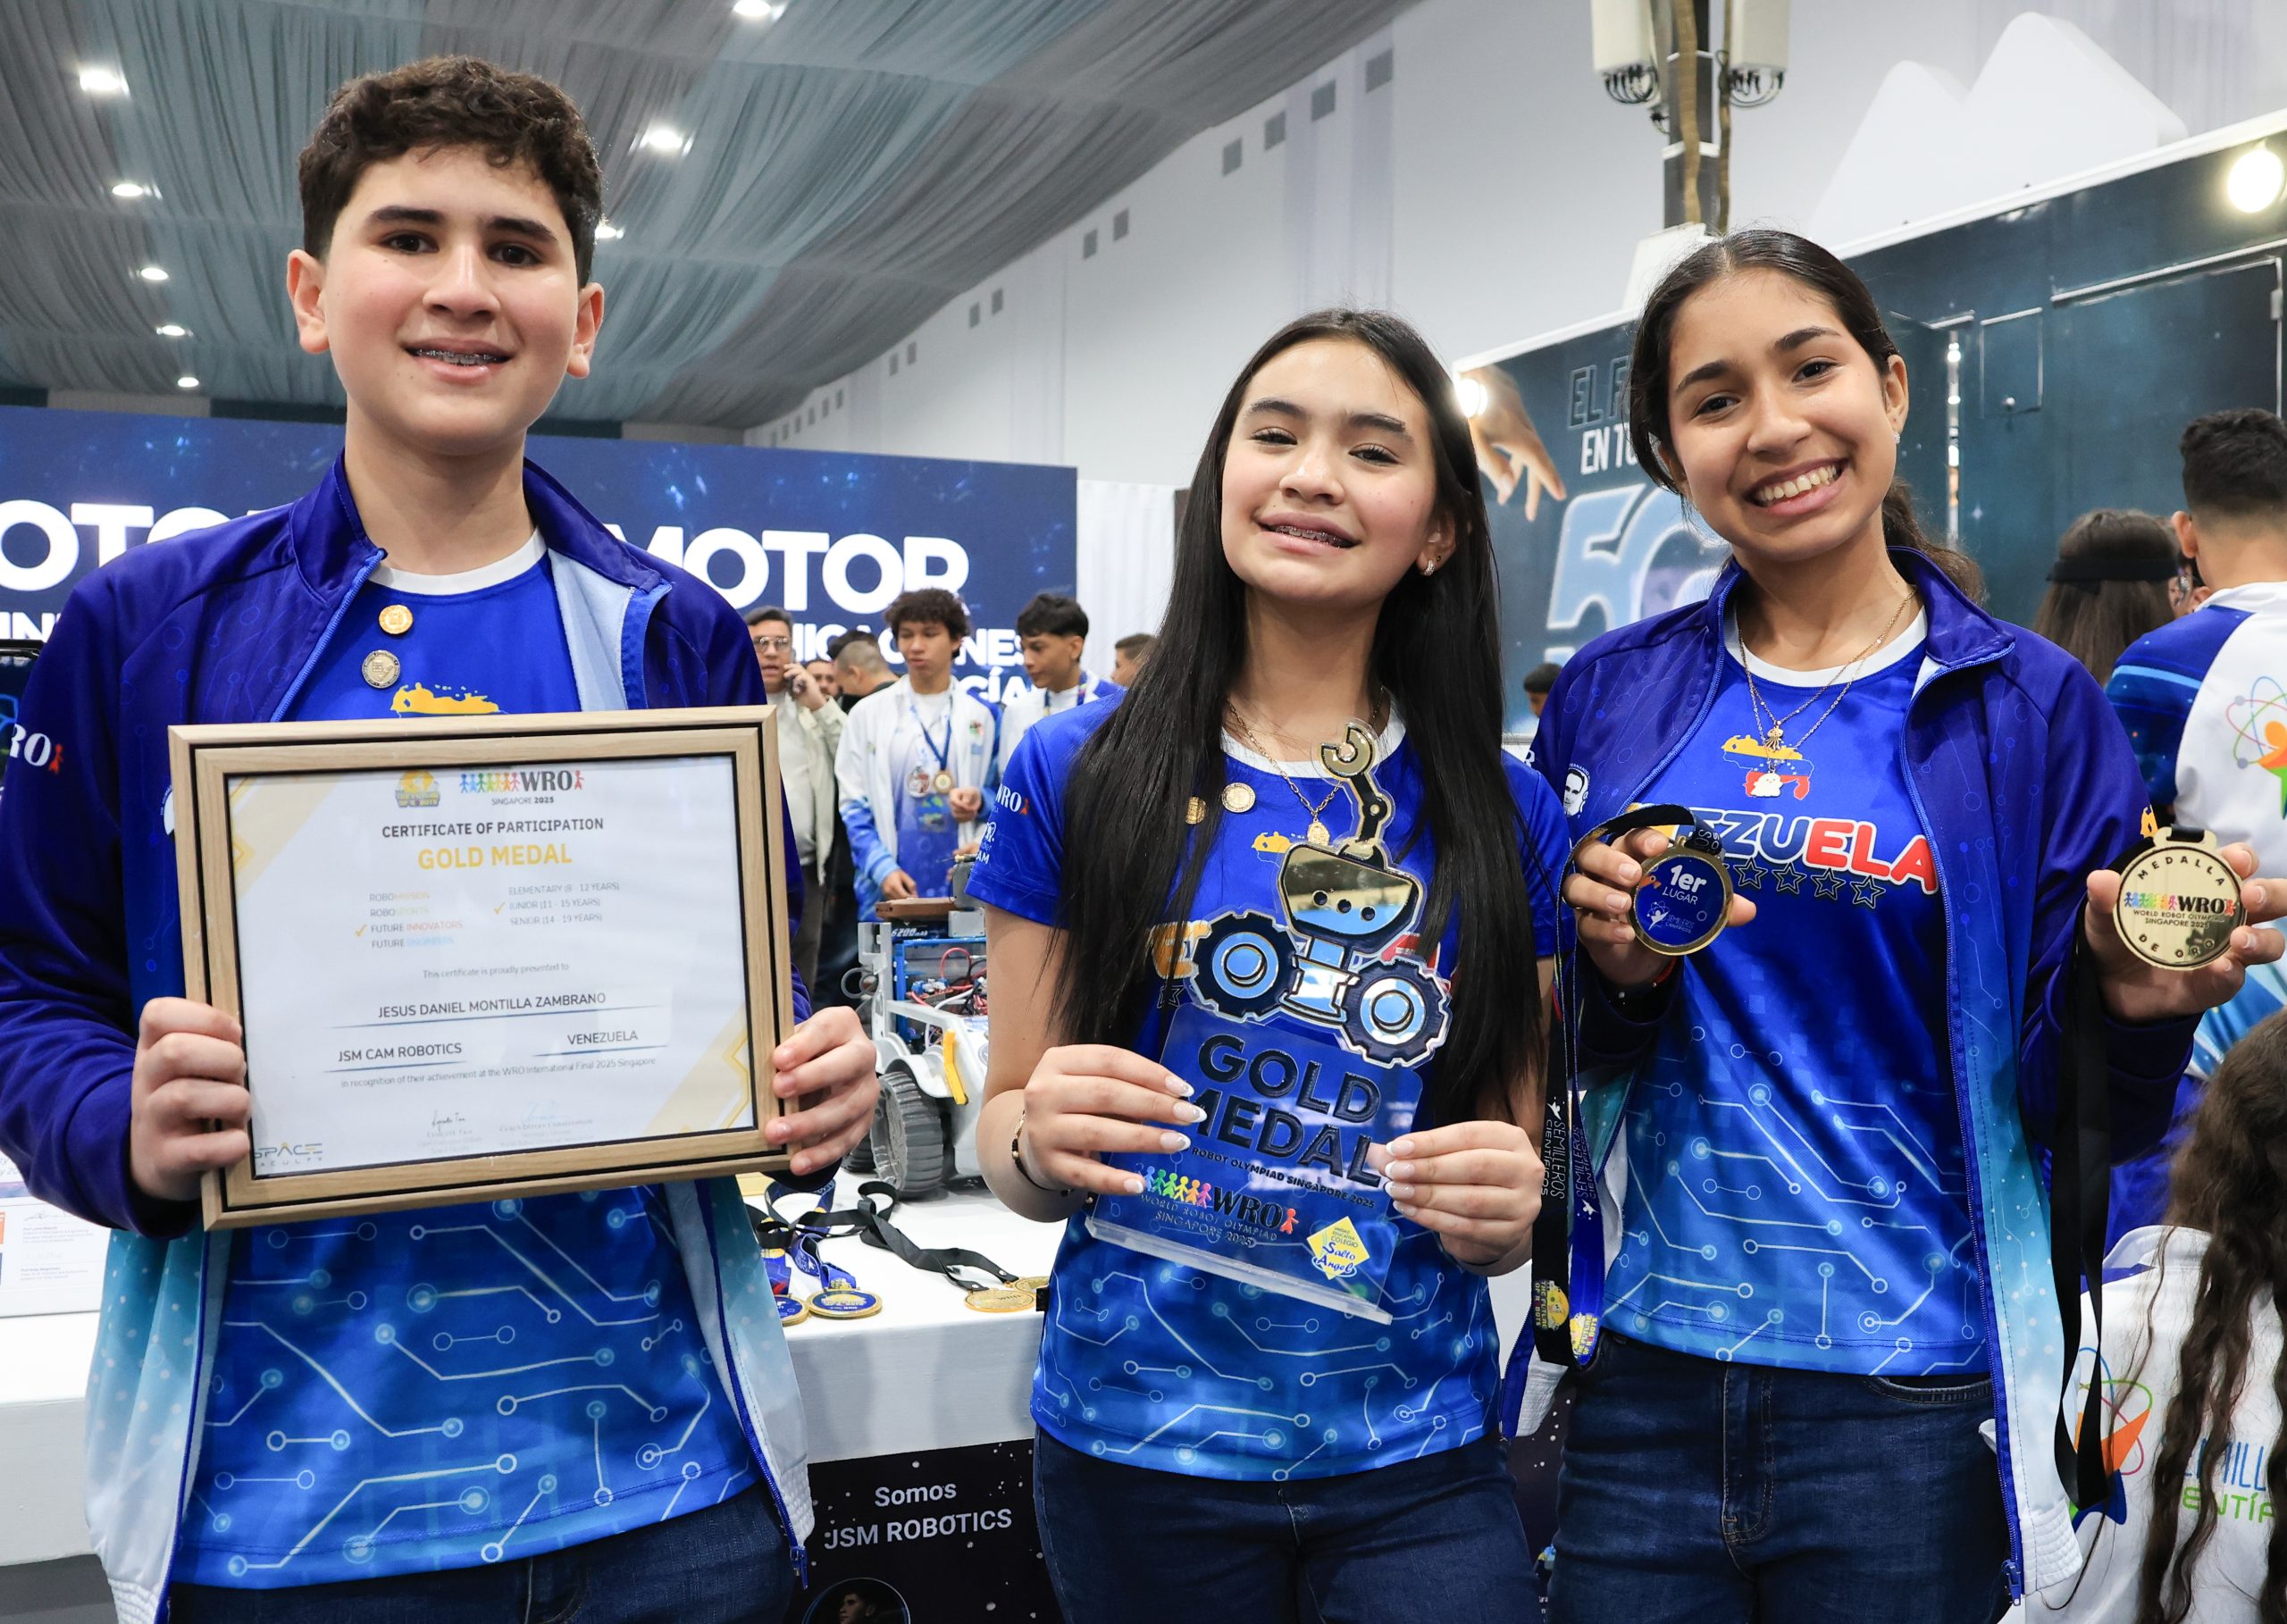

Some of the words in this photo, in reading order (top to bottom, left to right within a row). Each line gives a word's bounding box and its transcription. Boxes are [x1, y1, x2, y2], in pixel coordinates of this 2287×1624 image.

[1568, 364, 1604, 429] EL
[1580, 427, 1610, 474] EN
[520, 770, 572, 791] WRO
[491, 797, 533, 805] SINGAPORE
[534, 796, 554, 804] 2025
[381, 823, 473, 838] CERTIFICATE
[476, 822, 493, 834] OF
[498, 818, 604, 833] PARTICIPATION
[418, 847, 483, 869] GOLD
[491, 843, 572, 866] MEDAL
[1671, 865, 1706, 892] 1er
[2138, 856, 2225, 887] MEDALLA
[508, 885, 563, 895] ELEMENTARY
[1662, 886, 1698, 906] LUGAR
[2133, 909, 2158, 917] WORLD
[2178, 896, 2224, 914] WRO
[371, 924, 404, 933] FUTURE
[406, 920, 464, 931] INNOVATORS
[2145, 917, 2189, 927] SINGAPORE
[2191, 921, 2210, 929] 2025
[372, 939, 405, 949] FUTURE
[2139, 933, 2160, 952] DE
[2175, 939, 2215, 958] ORO
[423, 969, 440, 979] This
[440, 967, 480, 978] certificate
[490, 965, 519, 976] proudly
[520, 963, 557, 975] presented
[558, 963, 569, 971] to
[378, 1005, 416, 1018] JESUS
[419, 1002, 465, 1017] DANIEL
[469, 998, 532, 1013] MONTILLA
[535, 992, 606, 1008] ZAMBRANO
[567, 1030, 639, 1046] VENEZUELA
[338, 1050, 363, 1063] JSM
[365, 1047, 395, 1061] CAM
[398, 1042, 462, 1059] ROBOTICS
[350, 1076, 396, 1088] recognition
[406, 1075, 425, 1084] their
[427, 1071, 476, 1083] achievement
[488, 1068, 501, 1077] the
[526, 1063, 574, 1075] International
[574, 1061, 593, 1070] Final
[596, 1059, 616, 1069] 2025
[617, 1057, 657, 1069] Singapore
[1198, 1034, 1380, 1123] GOLD
[261, 1158, 322, 1166] ACULTY
[1550, 1120, 1566, 1200] SEMILLEROS
[1572, 1126, 1588, 1199] SEMILLEROS
[1192, 1147, 1228, 1163] ROBOT
[1231, 1159, 1285, 1181] OLYMPIAD
[1286, 1176, 1347, 1200] SINGAPORE
[1350, 1193, 1376, 1208] 2025
[1141, 1194, 1178, 1212] WORLD
[1183, 1207, 1219, 1223] ROBOT
[1224, 1218, 1278, 1241] OLYMPIAD
[1213, 1186, 1284, 1229] WRO
[1154, 1210, 1223, 1237] SINGAPORE
[1227, 1232, 1252, 1246] 2025
[1322, 1242, 1355, 1260] Salto
[1331, 1235, 1358, 1248] COLEGIO
[874, 1483, 957, 1508] Somos
[824, 1524, 879, 1550] JSM
[886, 1508, 1012, 1543] ROBOTICS
